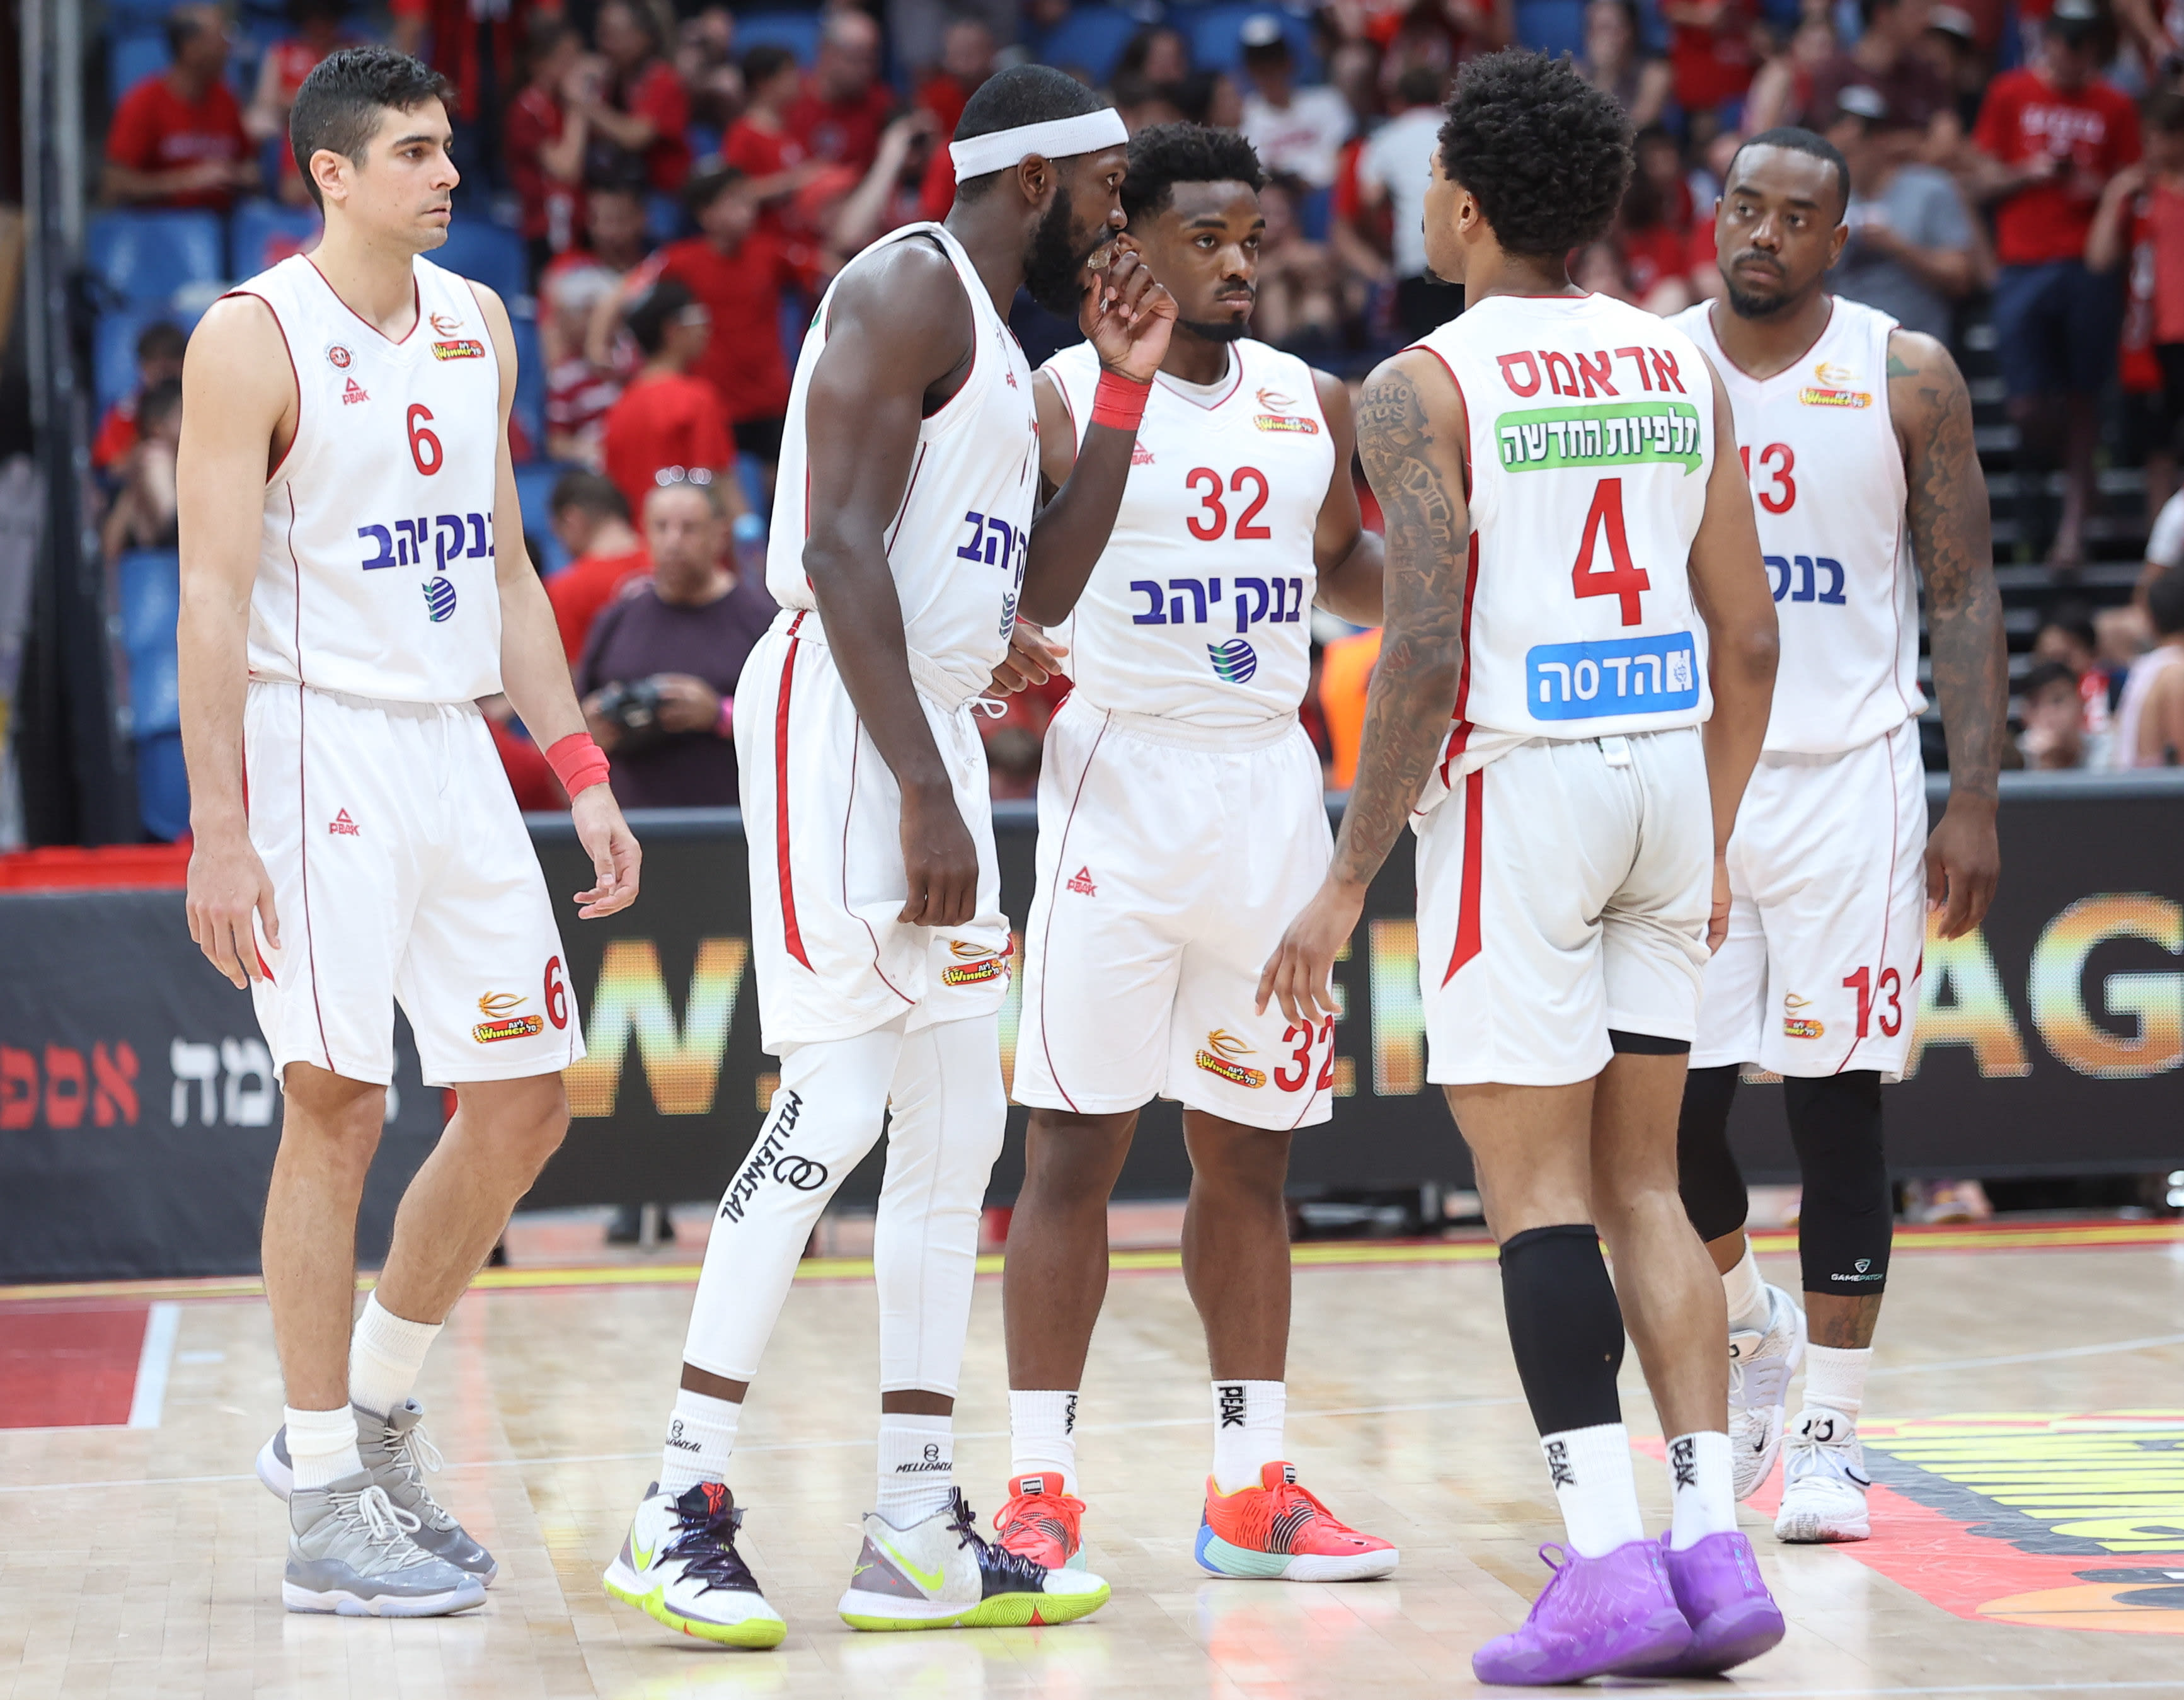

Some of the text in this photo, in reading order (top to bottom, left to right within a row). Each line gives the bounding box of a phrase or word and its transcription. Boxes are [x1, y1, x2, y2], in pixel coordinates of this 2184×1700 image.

[437, 346, 472, 359] Winner
[1496, 347, 1687, 398] אדאמס
[342, 389, 370, 405] PEAK
[1806, 391, 1851, 405] Winner
[406, 403, 443, 476] 6
[1260, 417, 1302, 431] Winner
[1501, 419, 1602, 463] החדשה
[1132, 453, 1155, 465] EAK
[1186, 466, 1271, 542] 32
[357, 517, 428, 570] יהב
[1572, 478, 1651, 626] 4
[1130, 577, 1302, 633] בנק יהב
[1537, 653, 1662, 703] הדסה
[329, 822, 360, 836] PEAK
[1066, 879, 1098, 897] PEAK
[544, 955, 568, 1030] 6
[950, 969, 992, 982] Winner
[1842, 966, 1902, 1038] 13
[480, 1026, 526, 1040] Winner
[1274, 1014, 1335, 1093] 32
[1203, 1055, 1244, 1081] Winner
[721, 1089, 803, 1224] MILLENNIAL
[1217, 1386, 1246, 1429] PEAK
[1544, 1440, 1578, 1491] PEAK
[1669, 1437, 1698, 1493] PEAK
